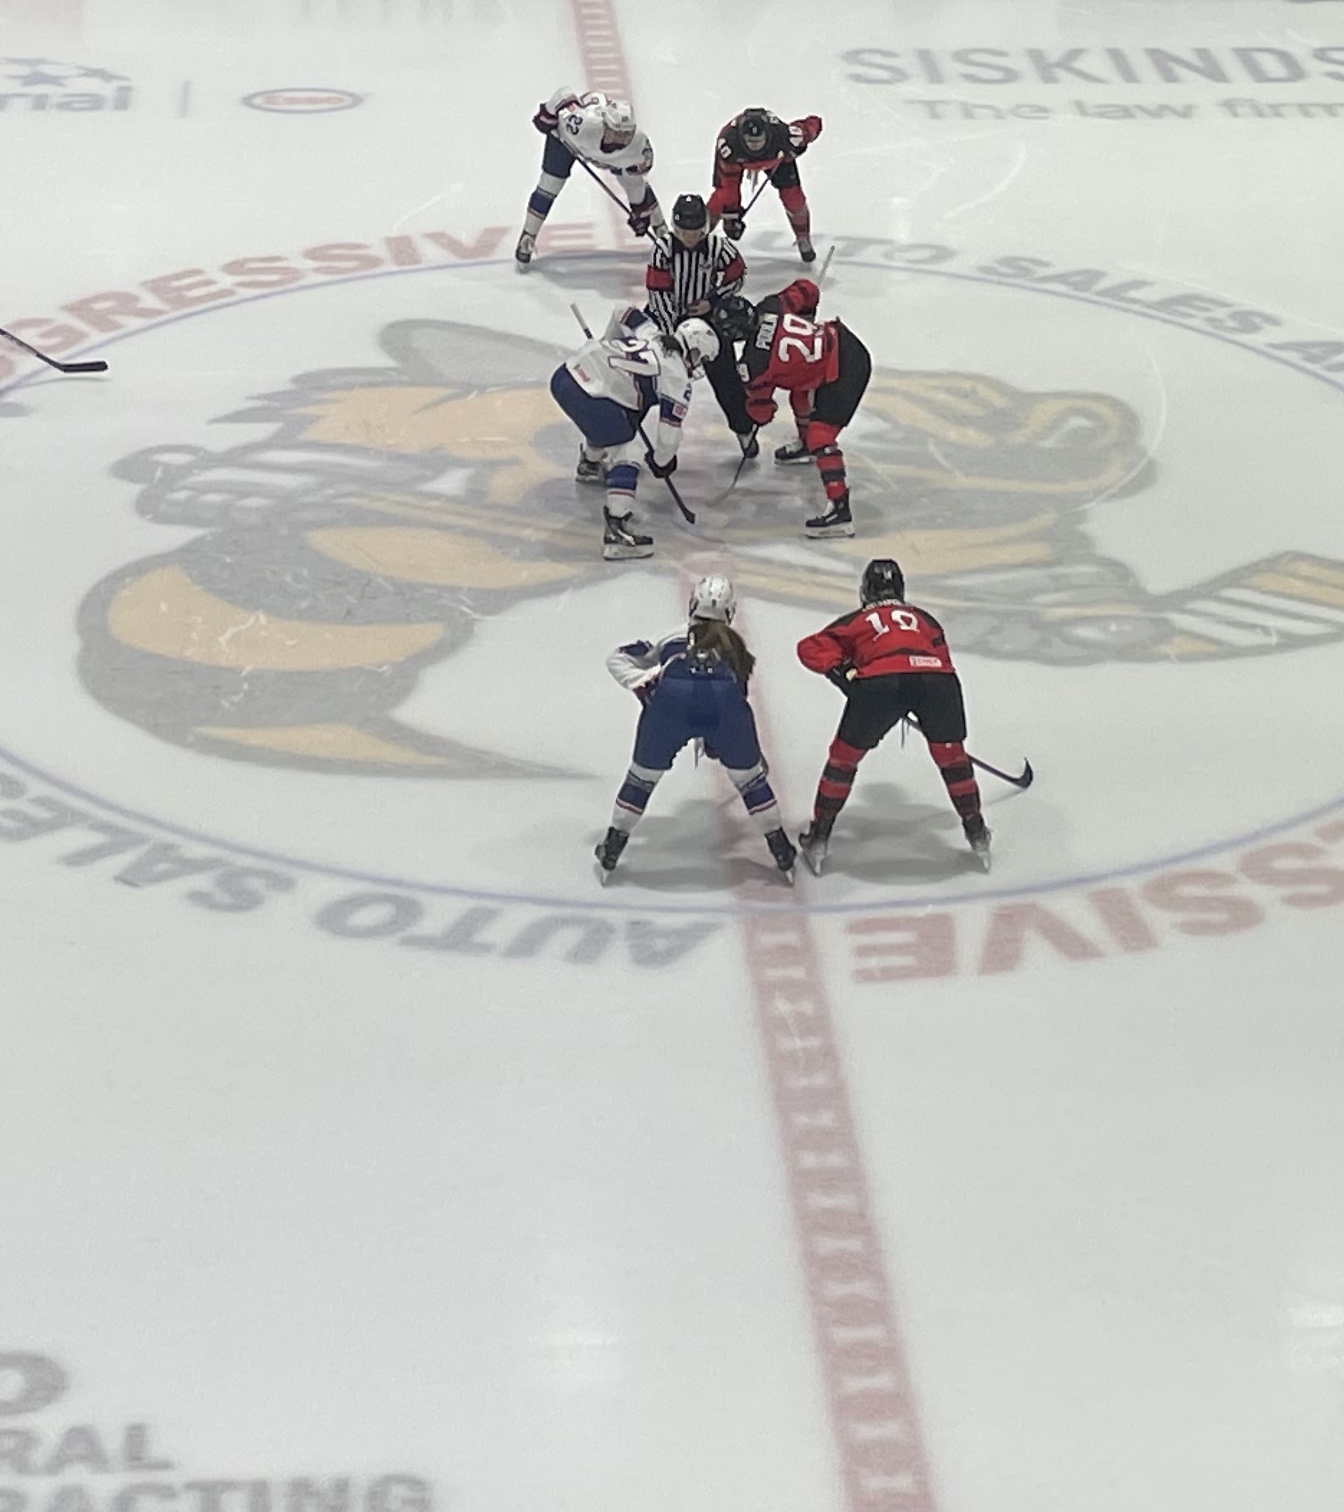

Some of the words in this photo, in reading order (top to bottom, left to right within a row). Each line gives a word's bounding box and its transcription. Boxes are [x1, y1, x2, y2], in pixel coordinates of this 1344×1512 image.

[900, 96, 1043, 121] The
[1073, 97, 1198, 120] law
[976, 252, 1288, 338] SALES
[312, 890, 725, 970] AUTO
